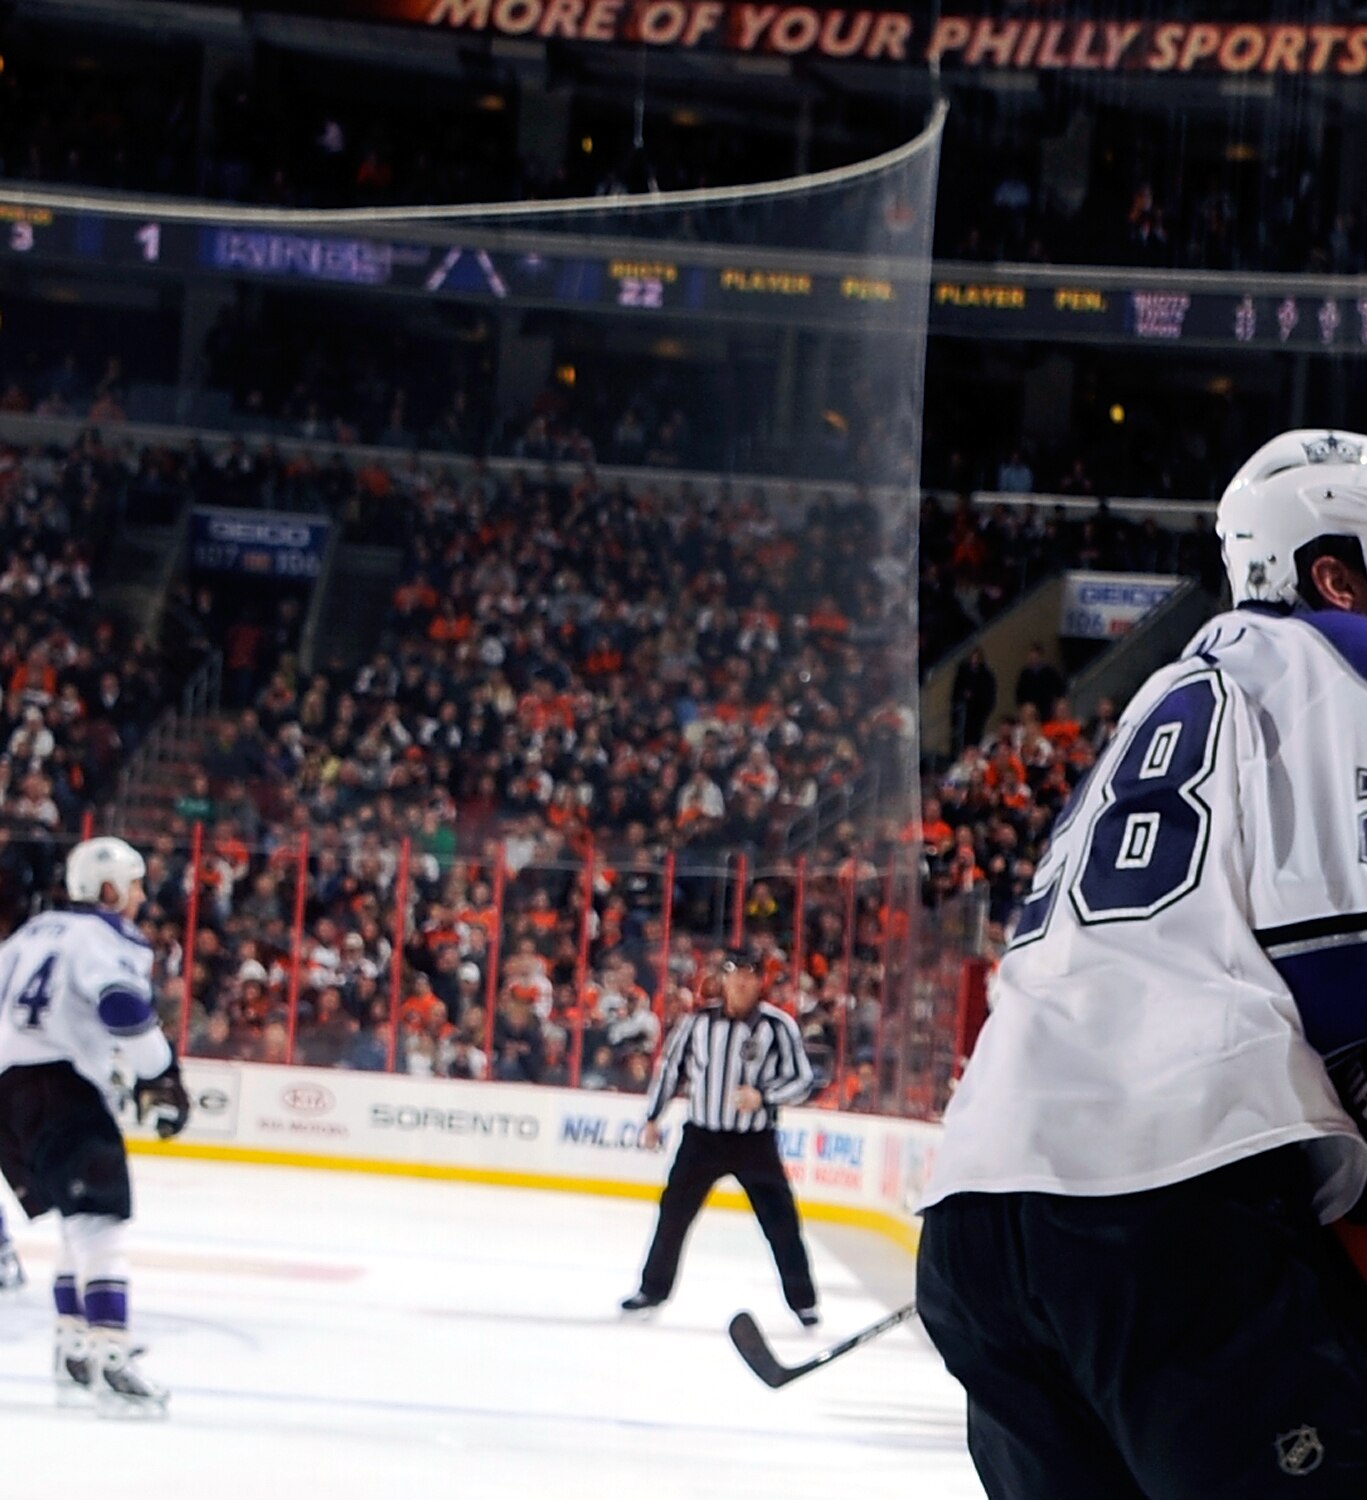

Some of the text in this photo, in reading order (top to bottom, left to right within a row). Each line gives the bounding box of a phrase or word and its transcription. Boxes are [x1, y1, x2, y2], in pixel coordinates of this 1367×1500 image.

[427, 0, 617, 40] MORE
[640, 2, 718, 46] OF
[737, 5, 912, 60] YOUR
[926, 17, 1141, 70] PHILLY
[134, 221, 162, 262] 1
[721, 268, 812, 296] PLAYER
[937, 282, 1026, 309] PLAYER
[14, 952, 60, 1030] 4
[369, 1103, 540, 1140] SORENTO
